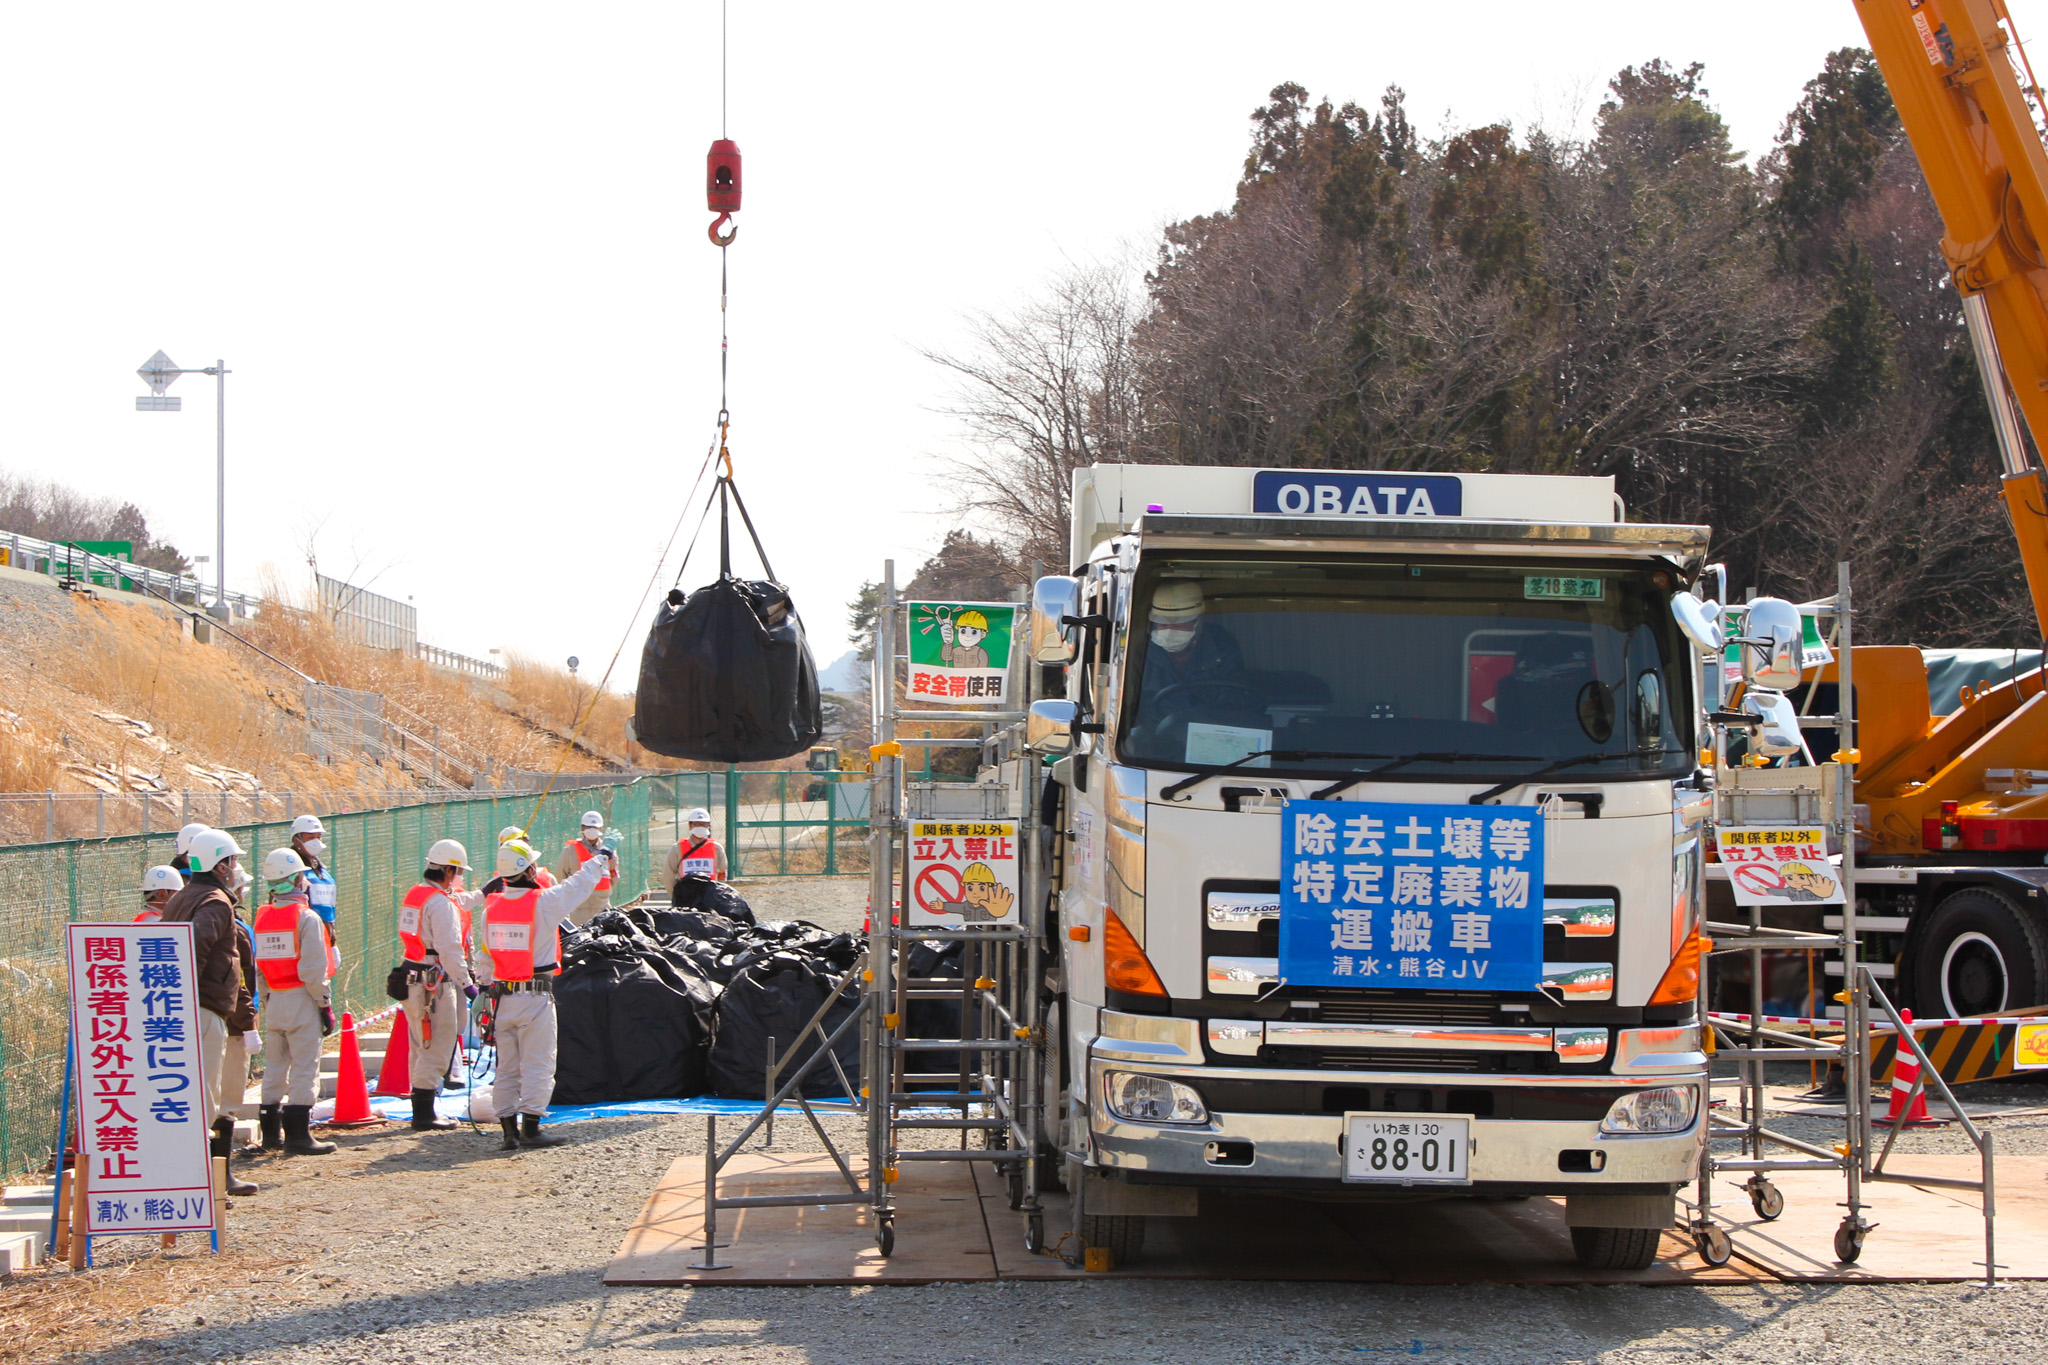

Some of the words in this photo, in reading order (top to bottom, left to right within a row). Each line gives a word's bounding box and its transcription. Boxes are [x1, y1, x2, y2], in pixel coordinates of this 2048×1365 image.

[1277, 483, 1436, 516] OBATA
[912, 672, 1003, 698] 安全帯使用
[923, 824, 1004, 836] 関係者以外
[1294, 812, 1532, 861] 除去土壌等
[1730, 831, 1812, 845] 関係者以外
[913, 837, 1014, 861] 立入禁止
[1723, 844, 1826, 862] 立入禁止
[1293, 860, 1530, 909] 特定廃棄物
[1330, 908, 1492, 954] 運搬車
[1332, 955, 1489, 979] 清水・熊谷JV
[136, 937, 191, 1124] 重機作業につき
[84, 936, 142, 1180] 関係者以外立入禁止
[1357, 1147, 1365, 1160] さ
[1370, 1137, 1456, 1172] 88-01
[97, 1197, 204, 1223] 清水・熊谷JV
